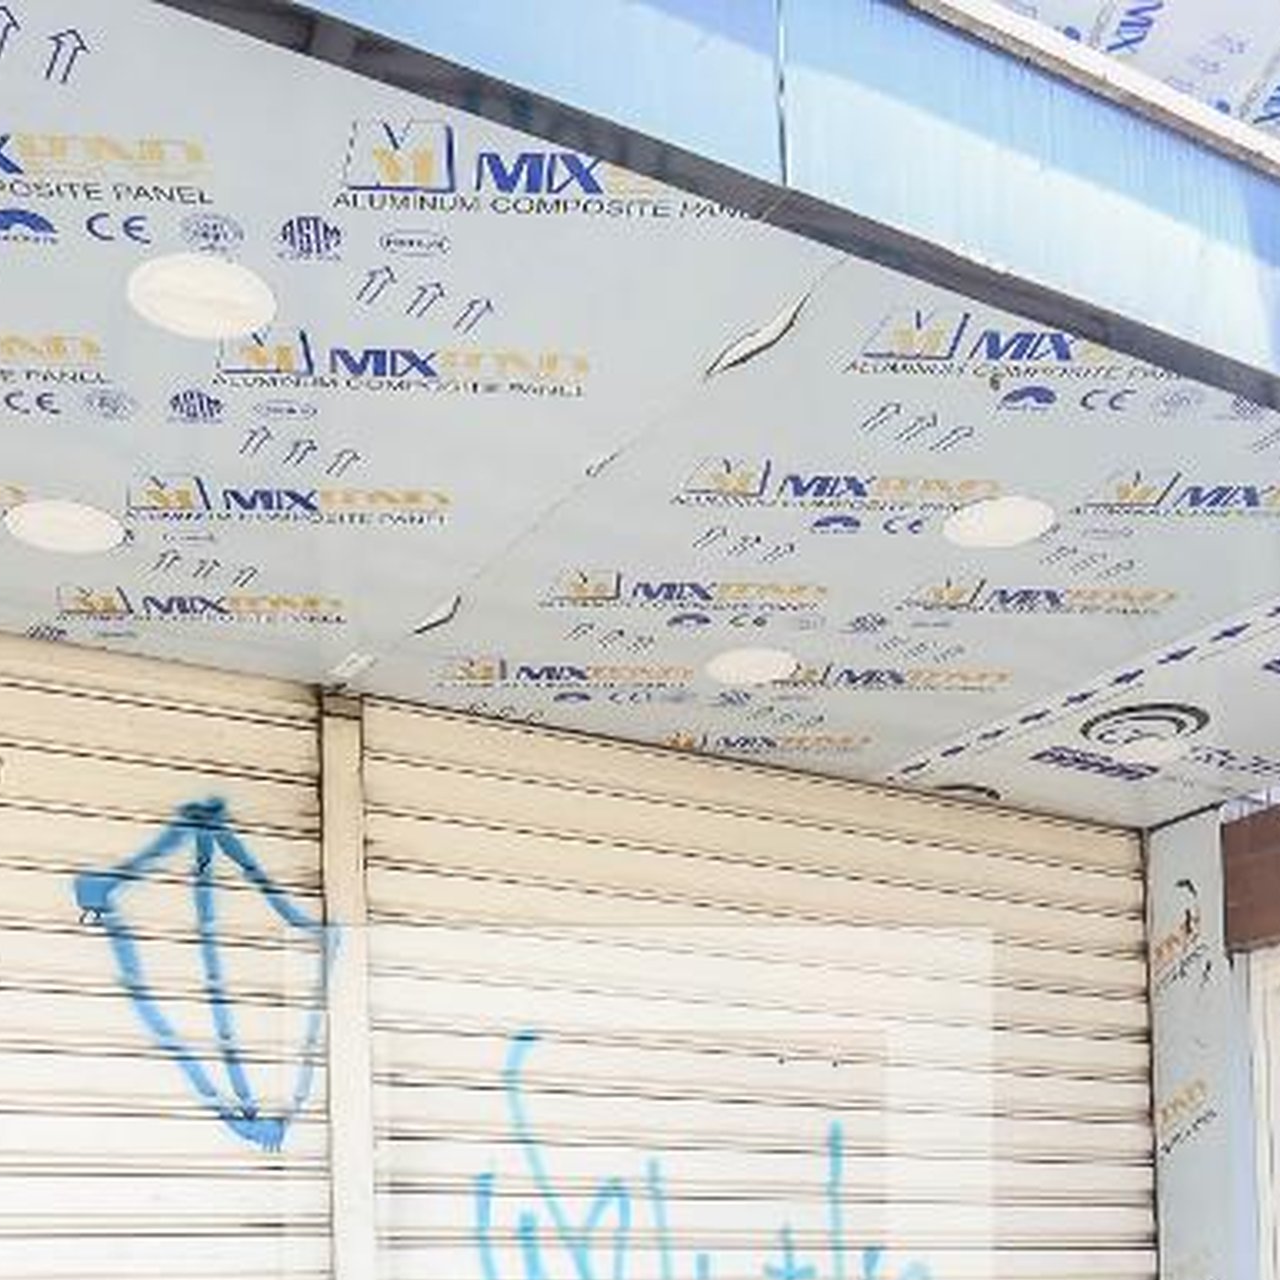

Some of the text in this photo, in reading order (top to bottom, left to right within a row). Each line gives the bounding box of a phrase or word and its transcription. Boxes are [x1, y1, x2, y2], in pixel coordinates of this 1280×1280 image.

[113, 184, 214, 205] PANEL
[334, 192, 481, 212] ALUMINUM
[491, 197, 672, 218] COMPOSITE
